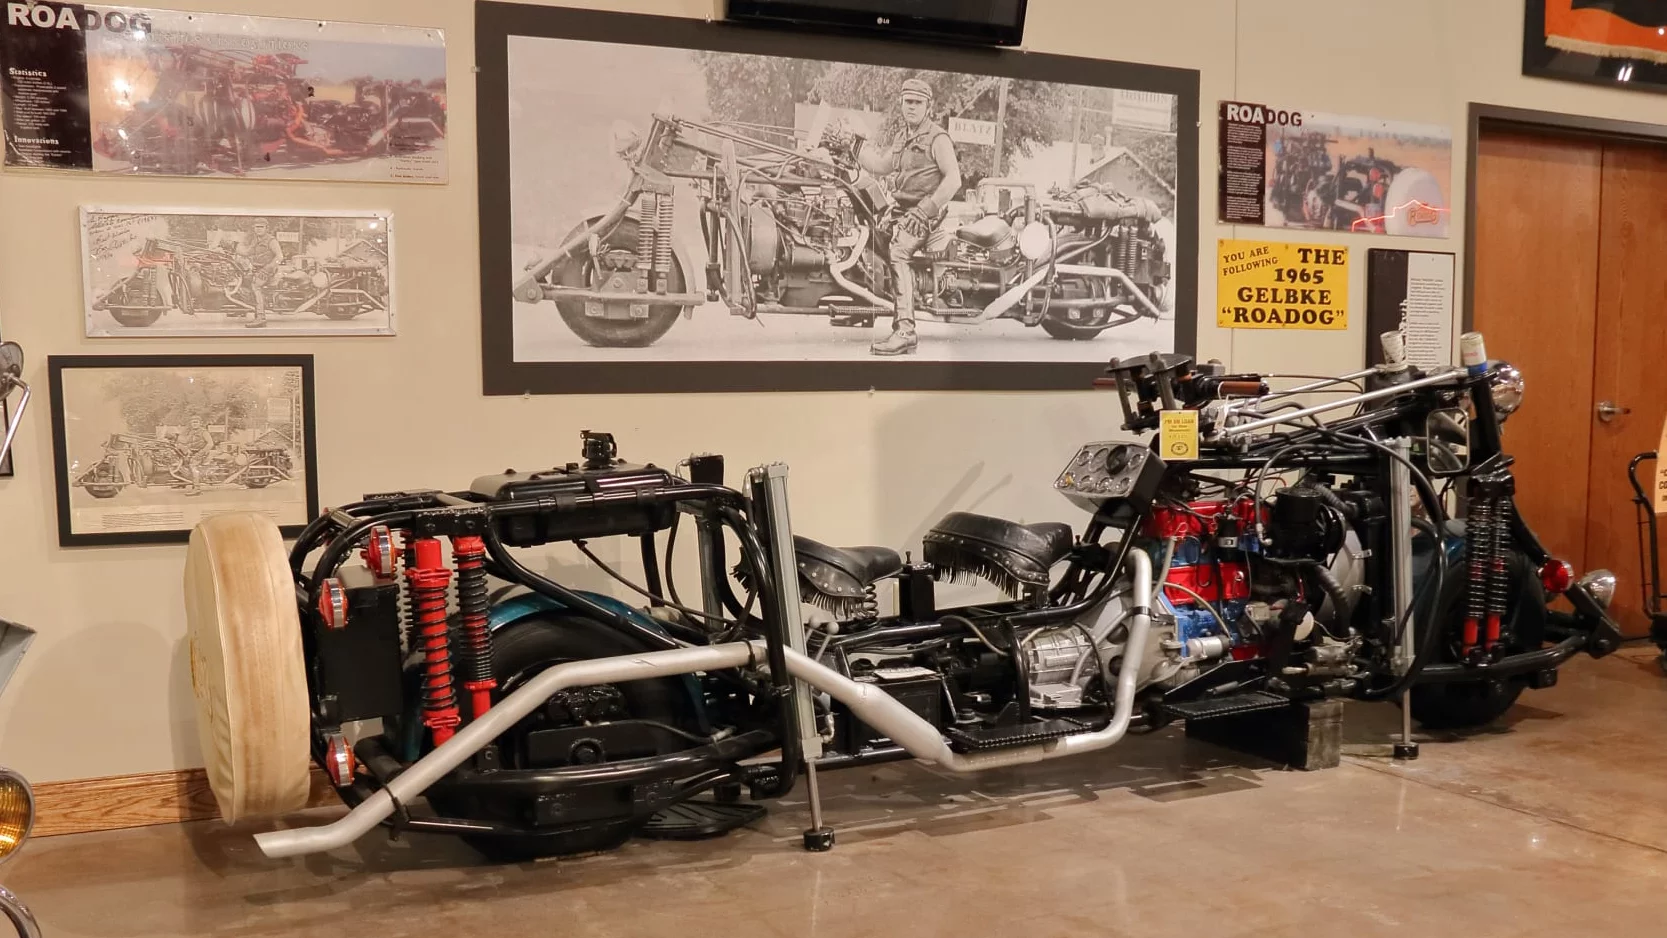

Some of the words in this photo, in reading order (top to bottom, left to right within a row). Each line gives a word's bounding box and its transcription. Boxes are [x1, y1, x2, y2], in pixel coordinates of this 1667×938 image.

[7, 2, 152, 33] ROADOG
[8, 67, 48, 77] Statistics
[1226, 103, 1302, 127] ROADOG
[14, 135, 60, 145] Innovations
[1223, 251, 1245, 264] YOU
[1249, 246, 1269, 258] ARE
[1297, 247, 1345, 265] THE
[1222, 256, 1279, 276] FOLLOWING
[1274, 268, 1324, 284] 1965
[1237, 286, 1332, 305] GELBKE
